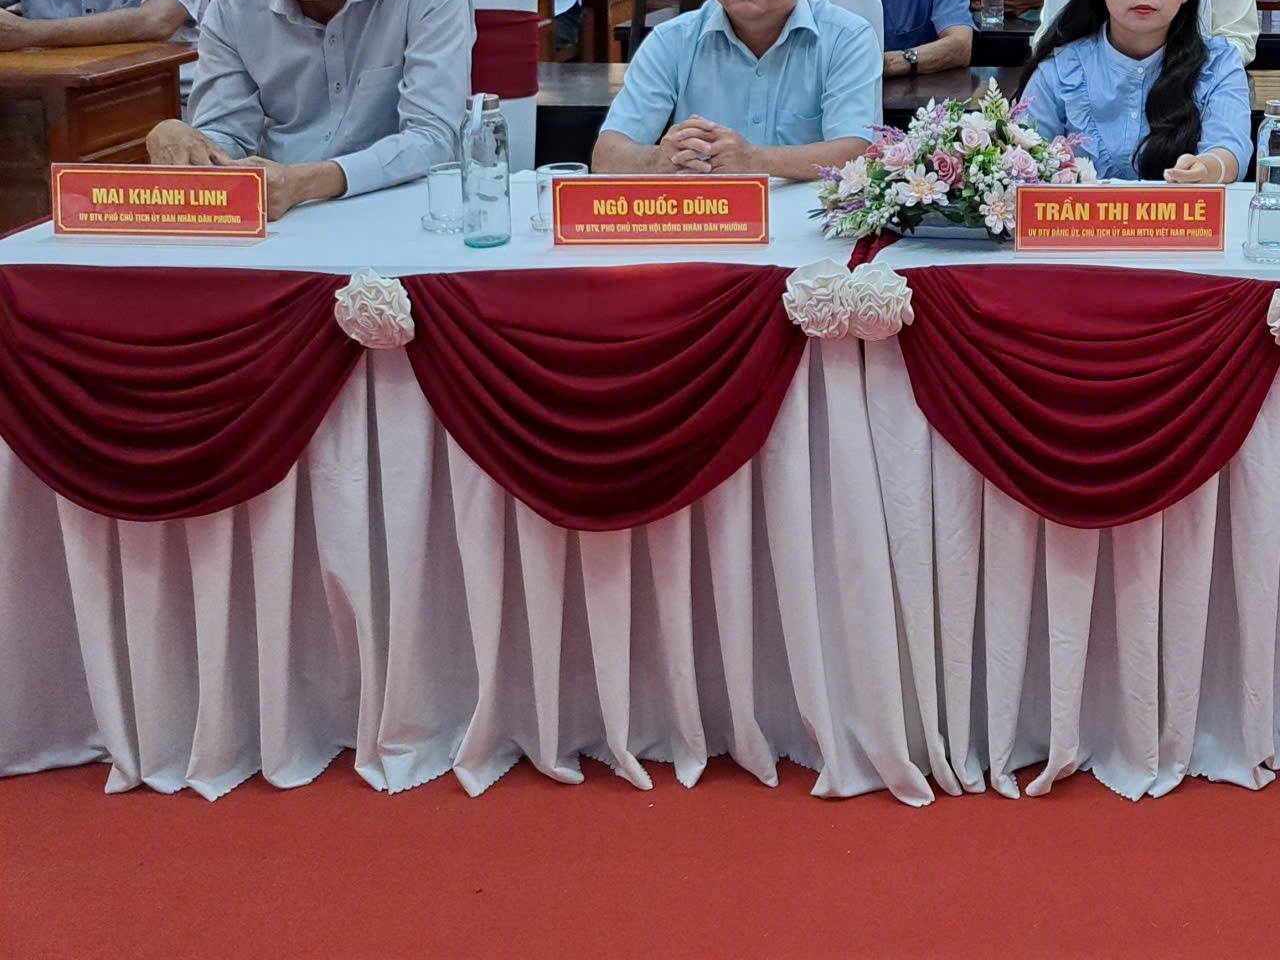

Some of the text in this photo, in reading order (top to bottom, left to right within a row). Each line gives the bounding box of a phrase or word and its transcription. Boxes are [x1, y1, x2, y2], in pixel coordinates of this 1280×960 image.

[92, 185, 228, 206] MAI KHÁNH LINH
[593, 194, 729, 216] NGÔ QUỐC DŨNG
[177, 213, 197, 223] NHÂN
[1034, 196, 1207, 224] TRẦN THỊ KIM LÊ
